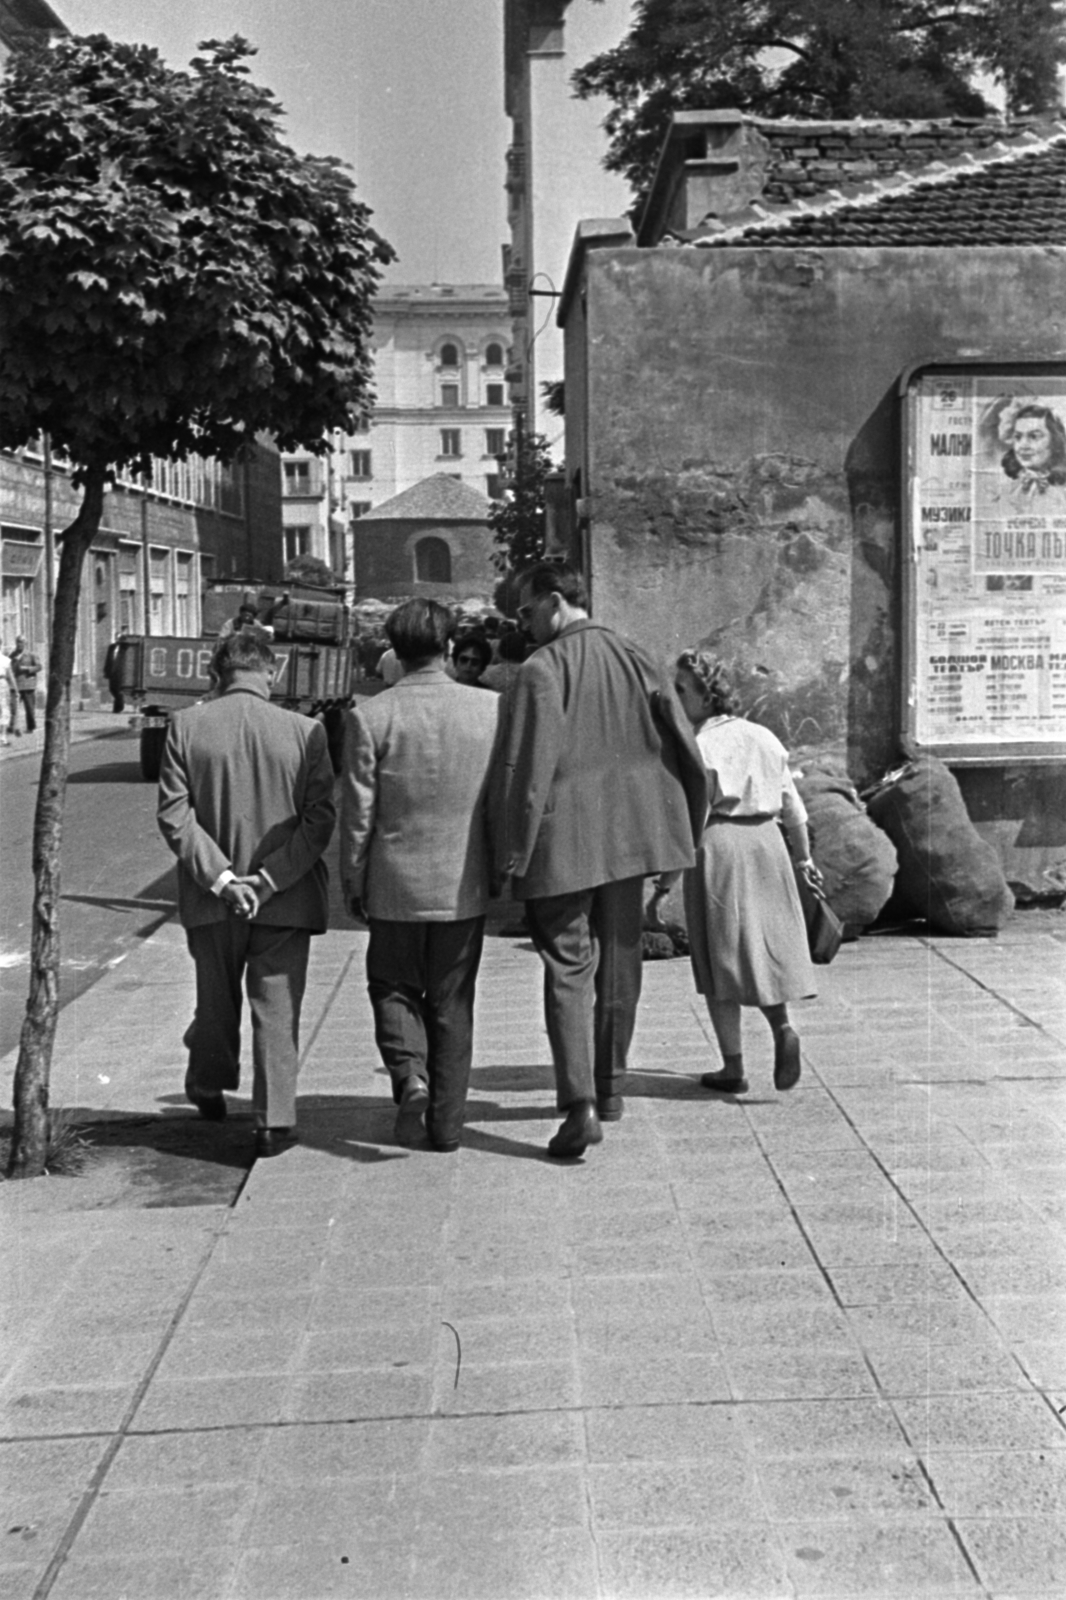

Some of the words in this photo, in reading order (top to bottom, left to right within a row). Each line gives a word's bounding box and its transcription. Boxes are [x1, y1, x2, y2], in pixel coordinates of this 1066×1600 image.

[985, 532, 1036, 559] ТОЧКА
[1042, 532, 1066, 559] ПЪ
[933, 664, 985, 673] ТЕАТЪР
[990, 654, 1045, 671] МОСКВА
